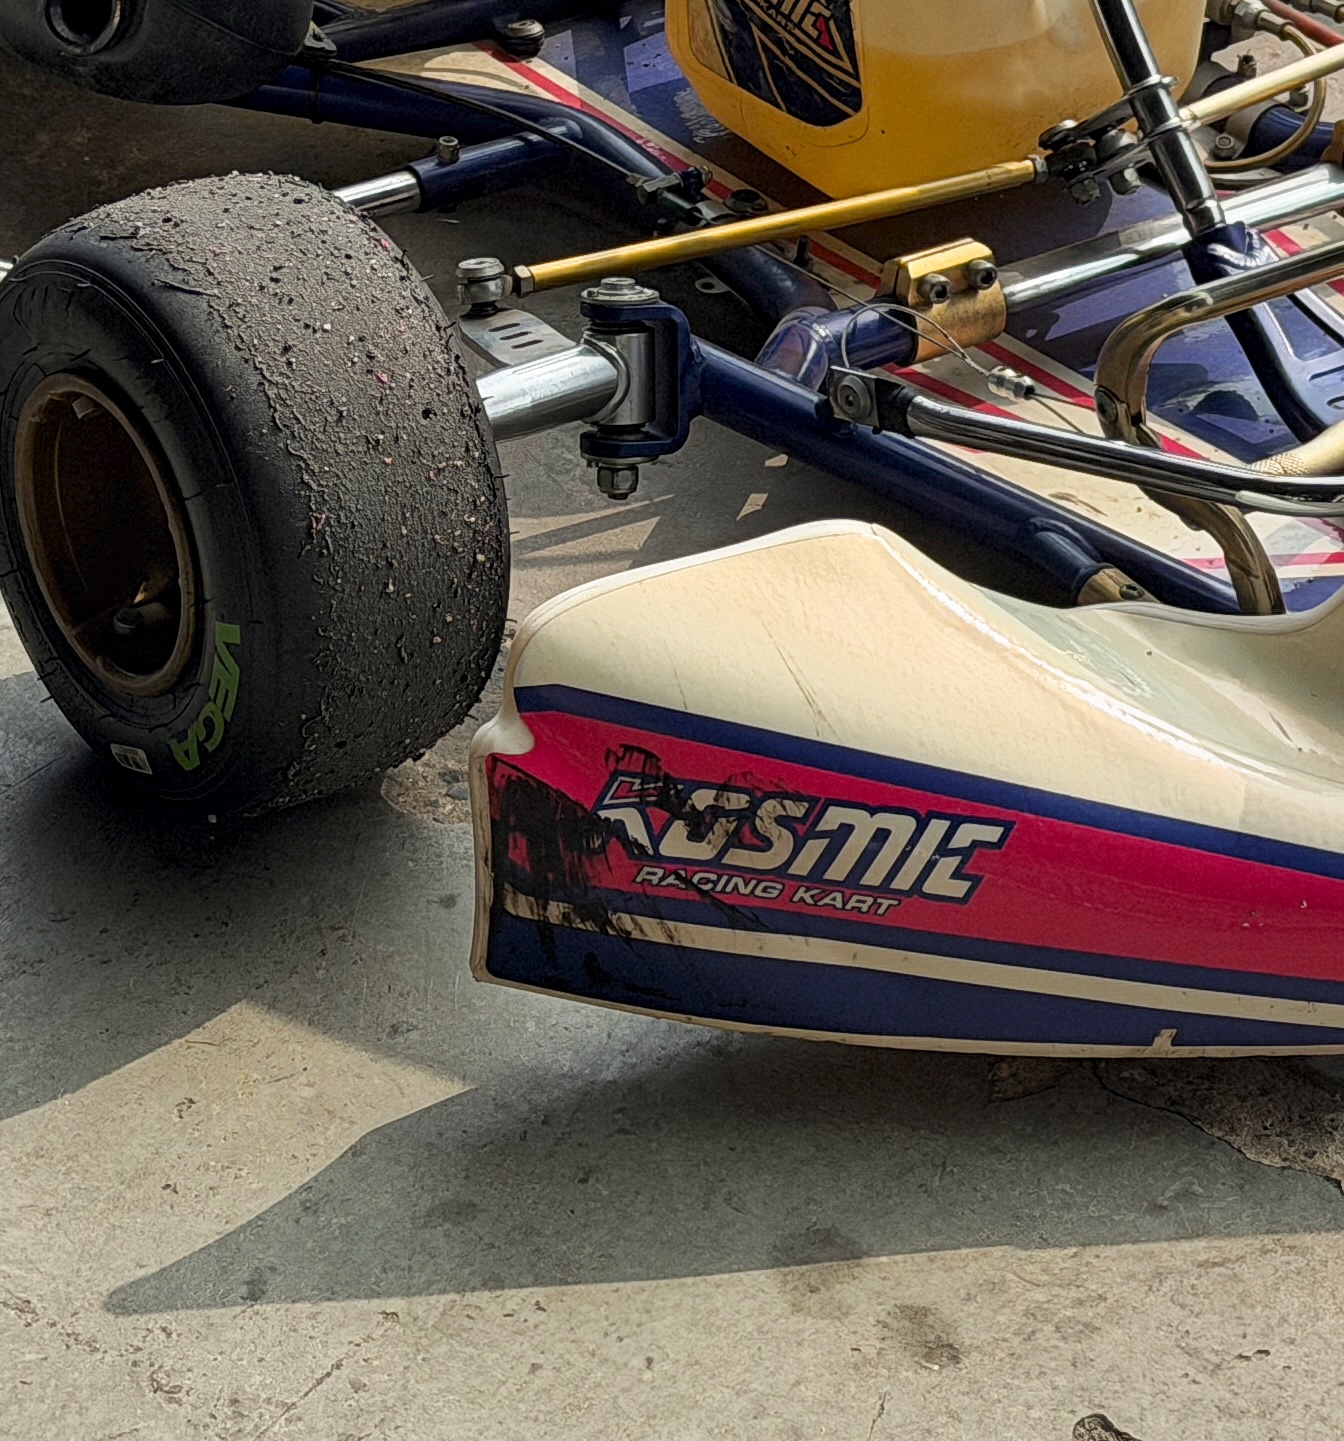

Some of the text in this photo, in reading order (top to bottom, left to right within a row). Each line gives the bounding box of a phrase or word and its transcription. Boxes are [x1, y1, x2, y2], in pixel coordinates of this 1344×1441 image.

[168, 621, 241, 771] VEGA
[594, 774, 1008, 901] KOSMIC
[634, 865, 902, 917] RACING KART
